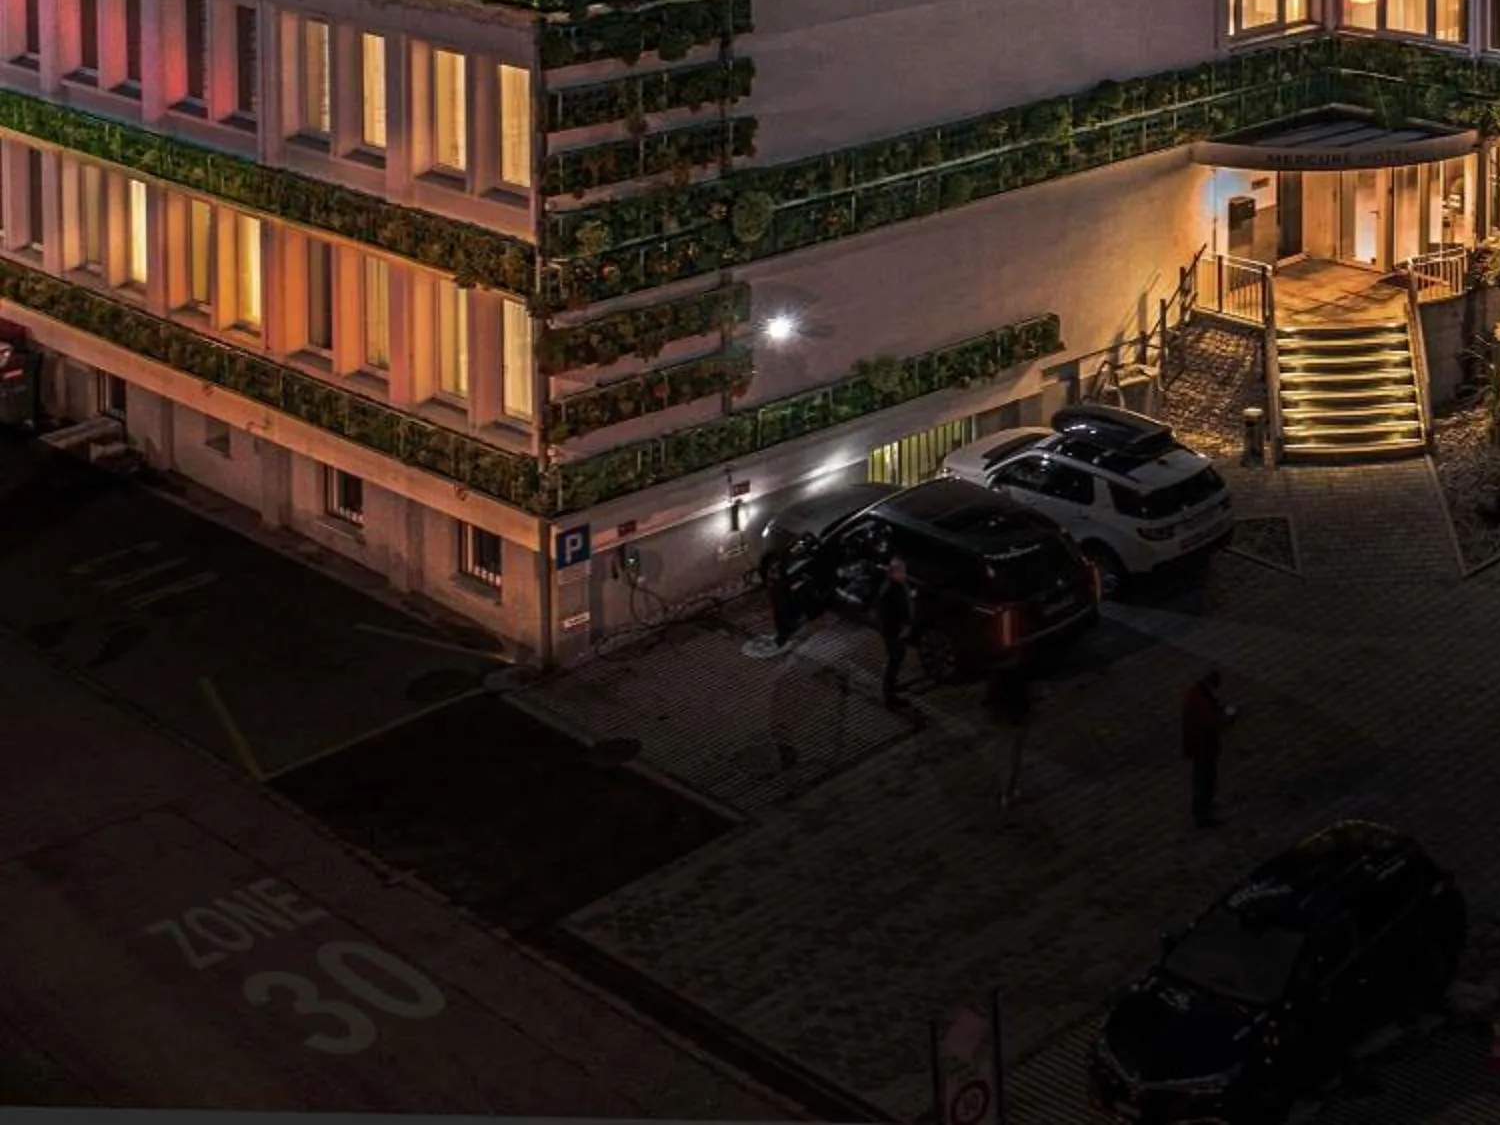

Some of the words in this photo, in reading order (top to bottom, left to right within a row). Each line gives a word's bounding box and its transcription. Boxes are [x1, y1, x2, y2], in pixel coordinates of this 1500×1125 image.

[564, 532, 583, 564] P
[144, 877, 331, 971] ZONE
[242, 940, 447, 1055] 30
